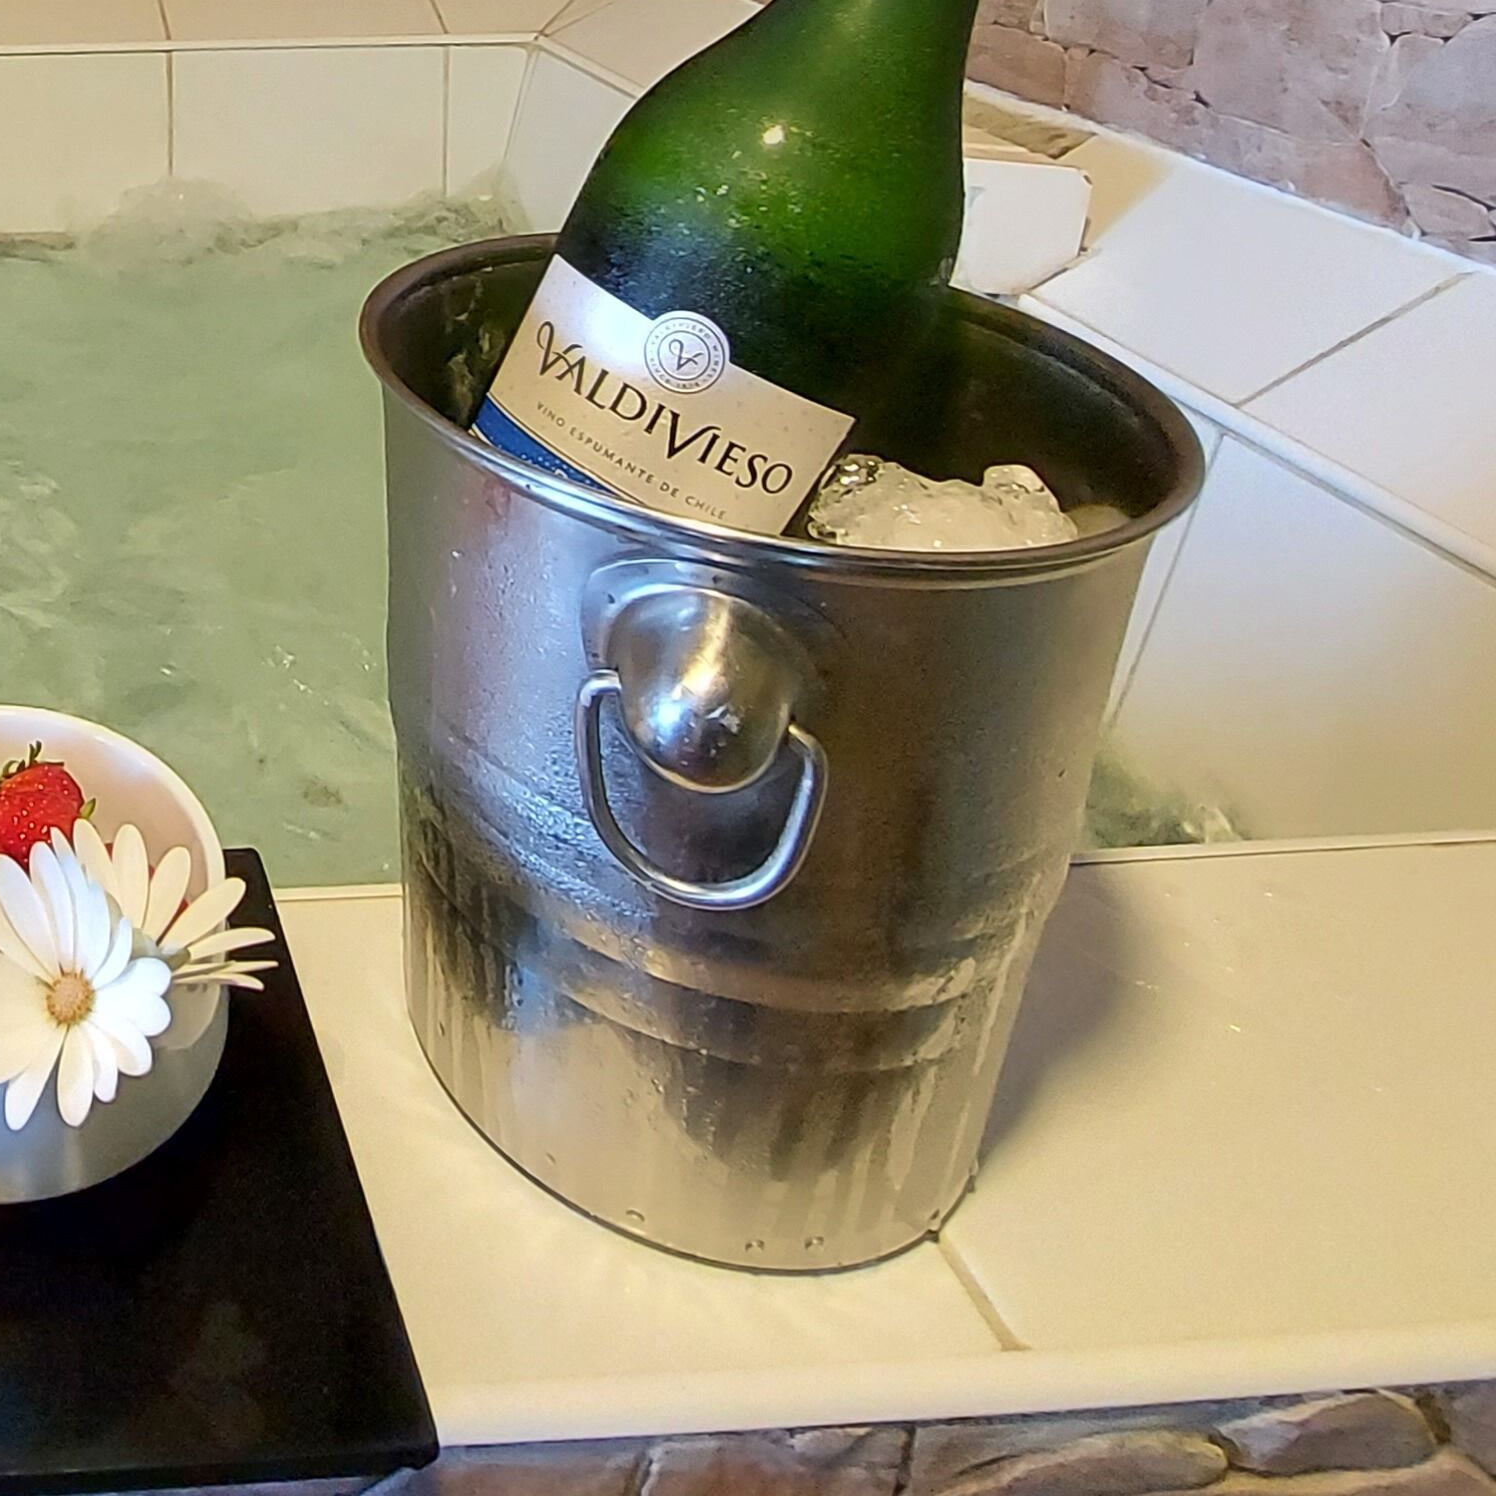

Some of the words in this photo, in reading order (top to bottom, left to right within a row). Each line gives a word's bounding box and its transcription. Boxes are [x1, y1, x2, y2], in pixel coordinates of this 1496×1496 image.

[536, 320, 794, 495] VALDIVIESO
[536, 401, 566, 428] VINO
[569, 426, 655, 485] ESPUMANTE
[659, 481, 680, 498] DE
[685, 495, 727, 521] CHILE
